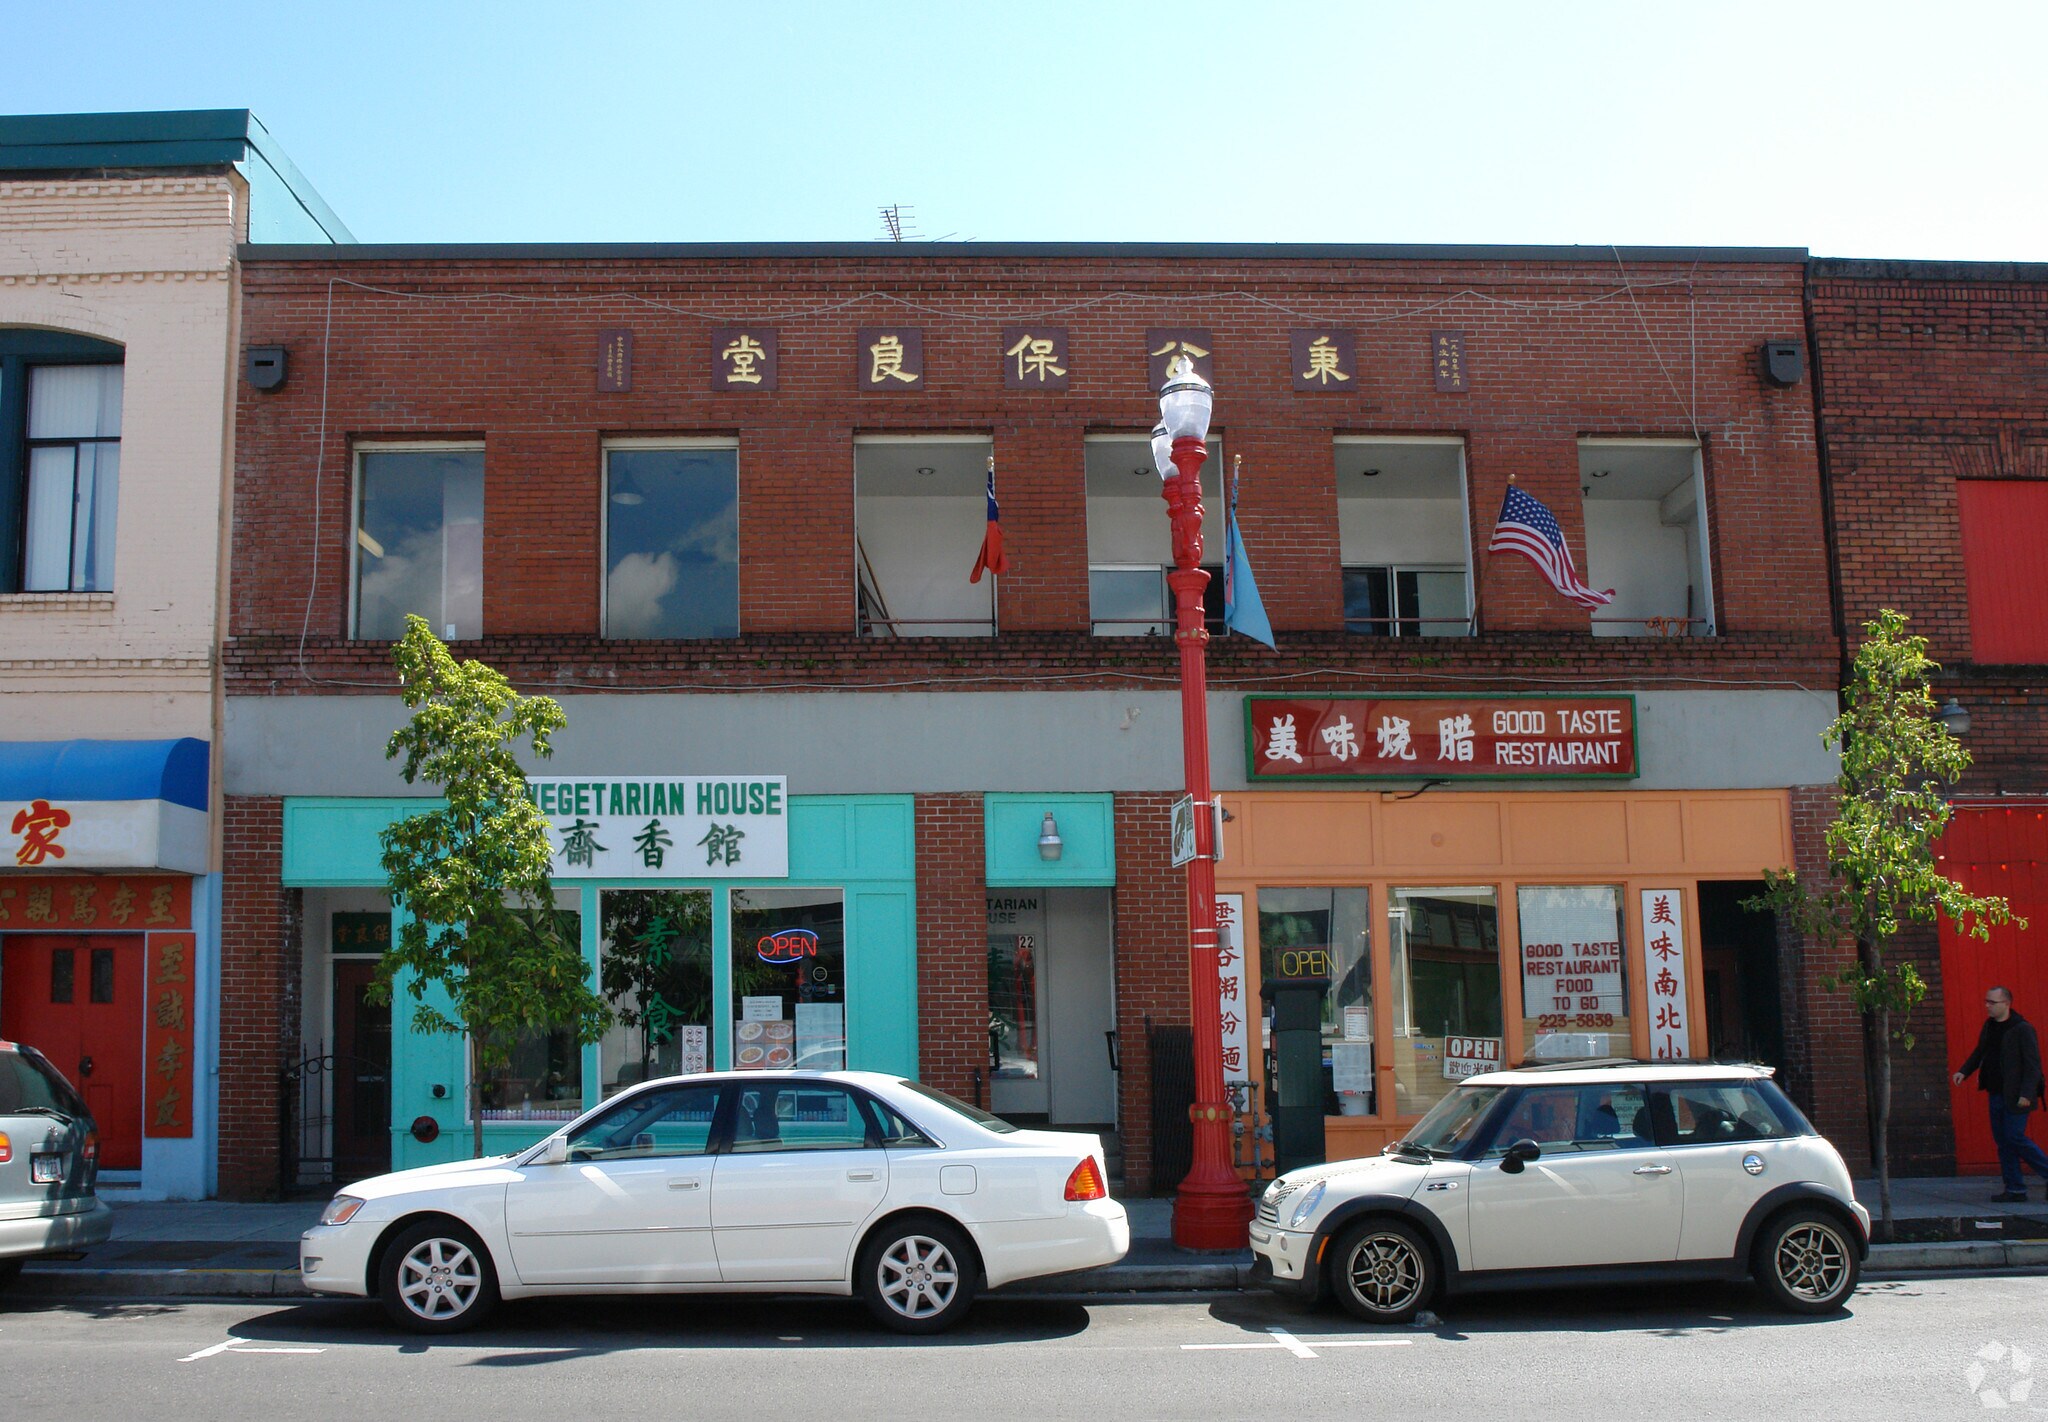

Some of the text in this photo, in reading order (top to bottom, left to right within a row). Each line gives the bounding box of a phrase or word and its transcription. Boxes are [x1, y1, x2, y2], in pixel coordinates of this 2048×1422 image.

[1493, 709, 1622, 735] GOOD TASTE
[1496, 741, 1621, 766] RESTAURANT
[697, 781, 782, 816] HOUSE
[11, 798, 71, 867] 家
[757, 935, 817, 957] OPEN
[1019, 936, 1034, 949] 22
[1525, 941, 1620, 958] GOOD TASTE
[1282, 950, 1340, 977] OPEN
[1526, 959, 1620, 976] RESTAURANT
[1555, 978, 1593, 994] FOOD
[1552, 995, 1599, 1011] TO GO
[1538, 1012, 1615, 1028] 223-3838
[1450, 1038, 1495, 1059] OPEN
